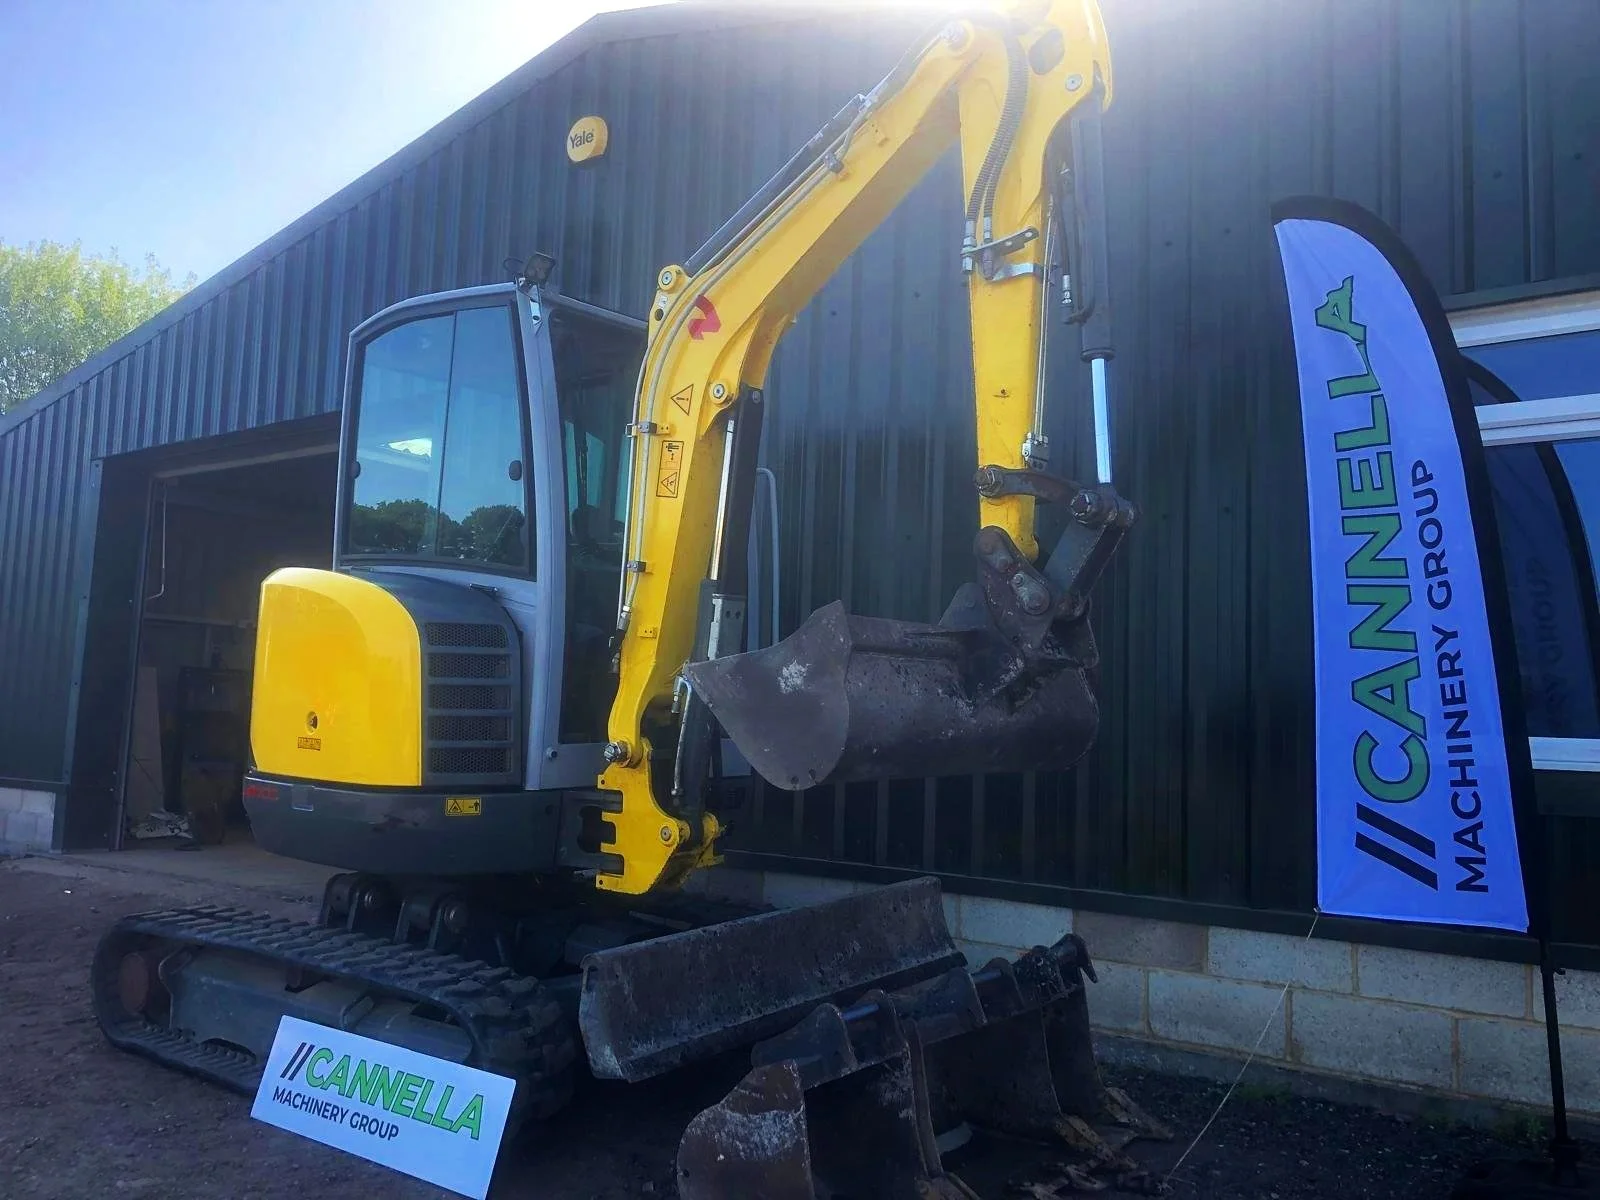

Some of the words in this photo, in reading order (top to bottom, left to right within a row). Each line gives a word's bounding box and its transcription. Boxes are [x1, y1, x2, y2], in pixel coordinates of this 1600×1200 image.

[570, 130, 594, 149] Yale
[1314, 275, 1431, 804] CANNELLA
[1411, 459, 1453, 611] GROUP
[1431, 624, 1489, 893] MACHINERY
[272, 1086, 350, 1125] MACHINERY
[349, 1112, 399, 1141] GROUP
[305, 1047, 485, 1141] CANNELLA
